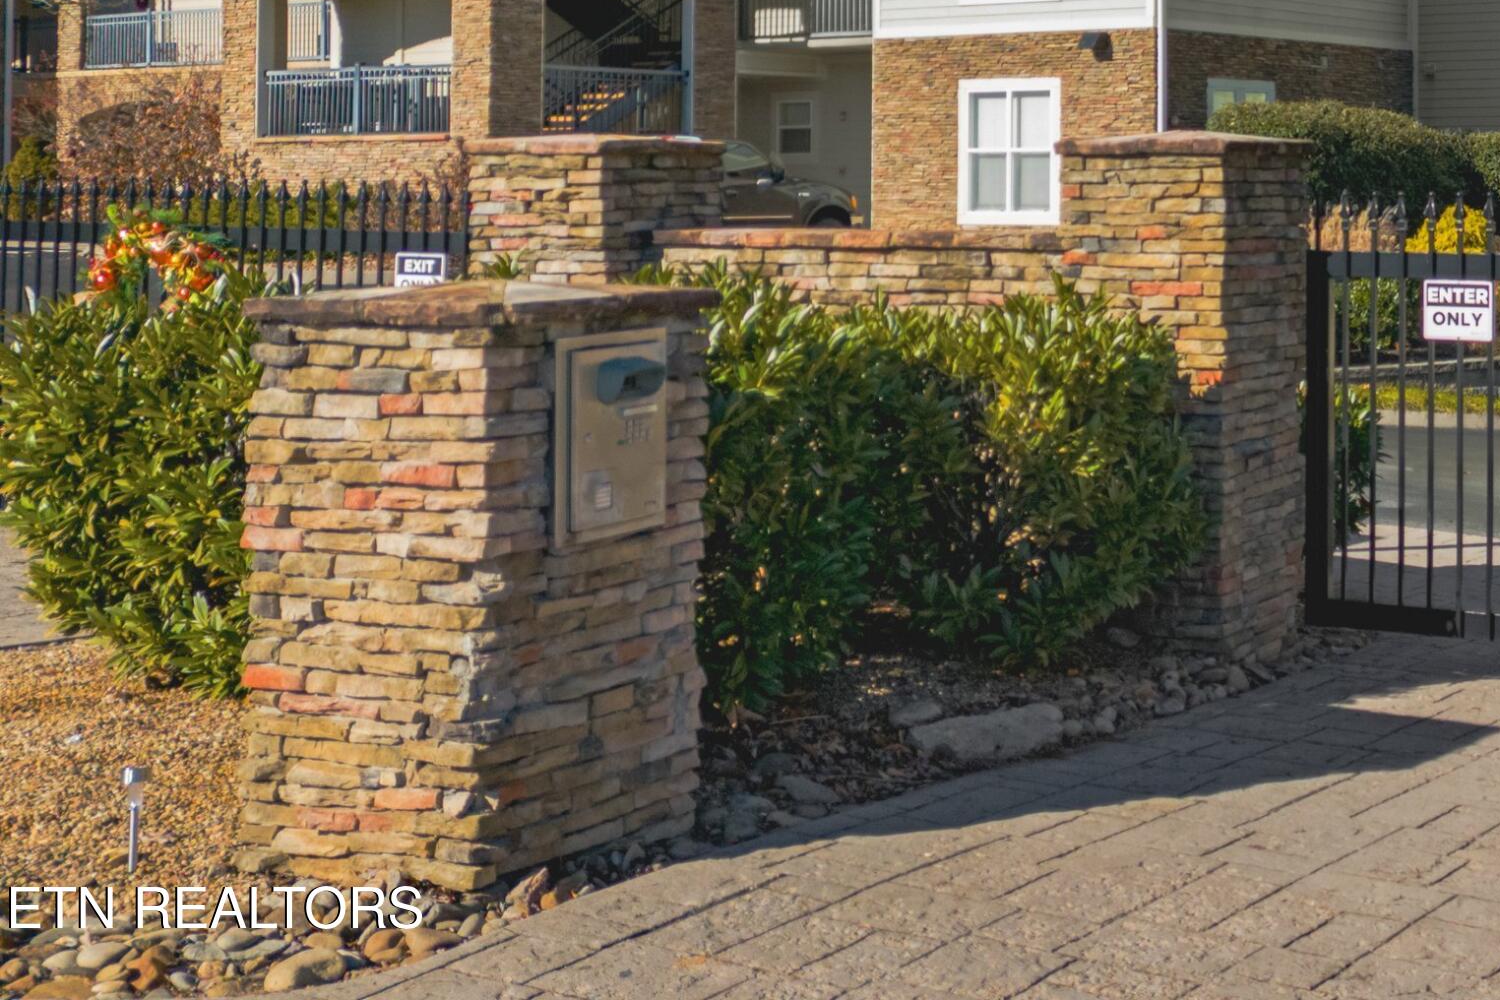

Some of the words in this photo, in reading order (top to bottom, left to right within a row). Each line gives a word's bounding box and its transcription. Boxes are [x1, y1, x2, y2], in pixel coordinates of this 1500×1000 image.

[404, 258, 435, 273] EXIT
[1427, 286, 1489, 305] ENTER
[1433, 311, 1482, 327] ONLY
